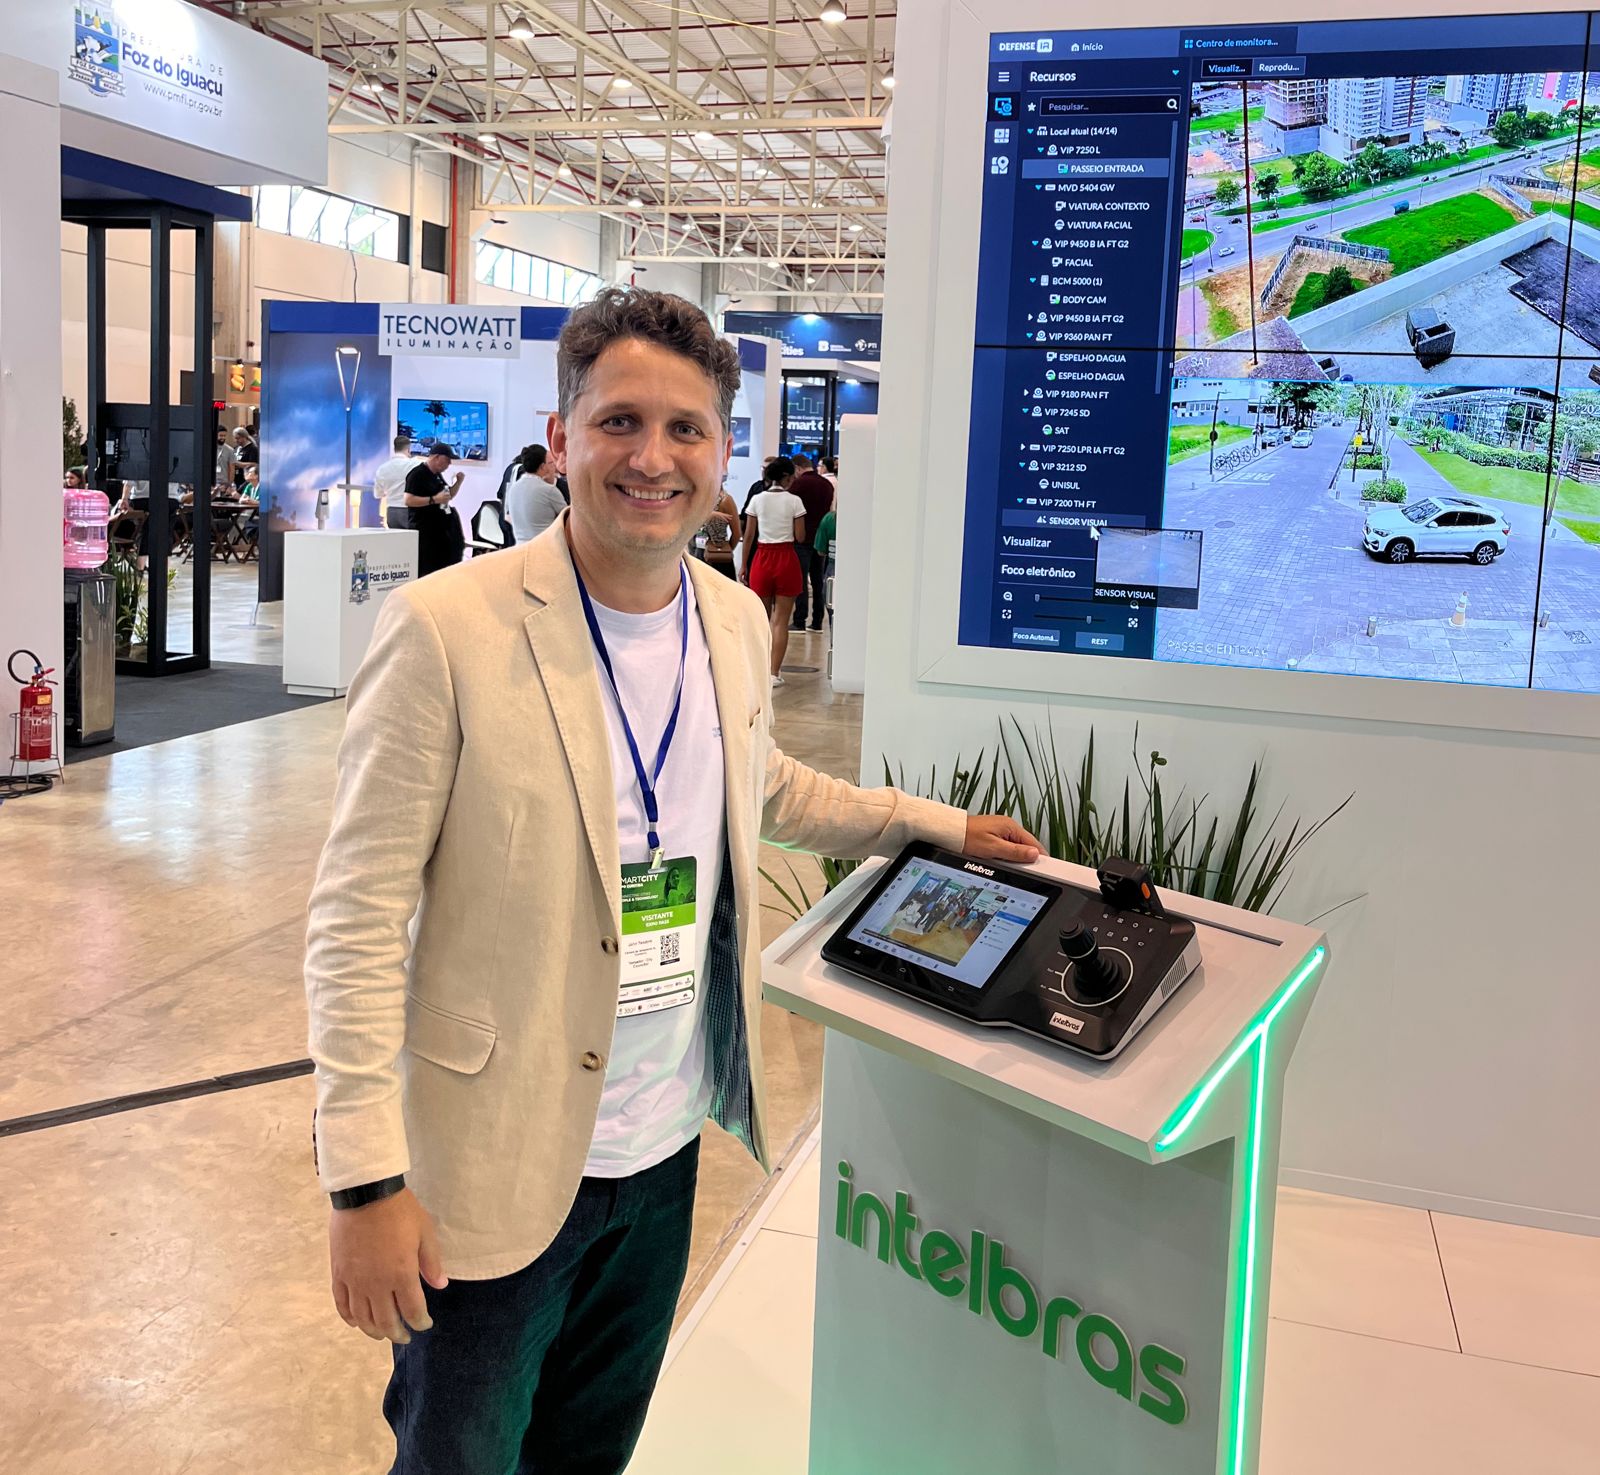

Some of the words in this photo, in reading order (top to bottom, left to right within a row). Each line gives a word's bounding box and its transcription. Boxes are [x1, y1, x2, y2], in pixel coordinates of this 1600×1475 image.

[999, 41, 1036, 52] DEFENSE
[1082, 42, 1104, 52] Início
[1195, 39, 1224, 48] Centro
[1224, 38, 1235, 47] de
[122, 41, 150, 70] Foz
[153, 55, 173, 77] do
[176, 62, 223, 97] Iguaçu
[1258, 63, 1300, 74] Reprodu...
[1029, 71, 1077, 83] Recursos
[143, 82, 223, 118] www.pmfi.pr.gov.br
[1050, 127, 1070, 136] Local
[1070, 127, 1090, 136] atual
[1090, 126, 1118, 137] (14/14)
[1060, 146, 1075, 155] VIP
[1075, 146, 1095, 155] 7250
[1095, 146, 1101, 154] L
[1070, 164, 1104, 173] PASSEIO
[1104, 164, 1145, 173] ENTRADA
[1058, 183, 1079, 192] MVD
[1079, 183, 1099, 192] 5404
[1099, 183, 1116, 192] GW
[1068, 202, 1104, 211] VIATURA
[1104, 202, 1150, 211] CONTEXTO
[1067, 221, 1103, 230] VIATURA
[1103, 221, 1133, 230] FACIAL
[1054, 240, 1069, 248] VIP
[1069, 240, 1090, 249] 9450
[1089, 240, 1096, 249] B
[1096, 240, 1106, 249] IA
[1106, 240, 1117, 249] FT
[1117, 240, 1130, 249] G2
[1064, 258, 1094, 267] FACIAL
[1052, 277, 1072, 286] BCM
[1072, 277, 1092, 286] 5000
[1092, 277, 1103, 287] (1)
[1062, 295, 1087, 304] BODY
[1086, 296, 1107, 304] CAM
[1050, 314, 1064, 323] VIP
[1065, 314, 1085, 323] 9450
[1085, 314, 1091, 323] B
[1092, 314, 1101, 323] IA
[1101, 314, 1112, 323] FT
[1112, 314, 1125, 323] G2
[383, 314, 517, 338] TECNOWATT
[1048, 332, 1063, 341] VIP
[1063, 332, 1083, 341] 9360
[1083, 333, 1102, 341] PAN
[1102, 333, 1113, 342] FT
[386, 337, 513, 353] ILUMINAÇÃO
[781, 344, 804, 356] ities
[1059, 353, 1096, 362] ESPELHO
[1096, 354, 1127, 363] DAGUA
[1190, 357, 1212, 368] SAT
[1058, 371, 1095, 380] ESPELHO
[1094, 372, 1126, 381] DAGUA
[1045, 389, 1060, 398] VIP
[1060, 390, 1080, 398] 9180
[1080, 391, 1098, 399] PAN
[1098, 391, 1109, 399] FT
[1044, 407, 1059, 416] VIP
[1059, 408, 1079, 417] 7245
[1079, 409, 1091, 417] SD
[780, 420, 817, 431] mart
[1054, 426, 1070, 435] SAT
[1042, 444, 1057, 453] VIP
[1057, 445, 1077, 453] 7250
[1077, 445, 1093, 454] LPR
[1093, 446, 1102, 454] IA
[1102, 446, 1113, 455] FT
[1113, 447, 1126, 456] G2
[1041, 462, 1056, 471] VIP
[1056, 463, 1075, 471] 3212
[1075, 463, 1087, 472] SD
[1051, 481, 1081, 490] UNISUL
[1039, 498, 1053, 507] VIP
[1053, 499, 1074, 508] 7200
[1073, 499, 1085, 508] TH
[1085, 500, 1097, 509] FT
[1049, 516, 1081, 526] SENSOR
[1002, 535, 1052, 548] Visualizar
[369, 572, 381, 582] Foz
[381, 571, 390, 581] do
[390, 570, 410, 582] Iguaçu
[1001, 564, 1025, 576] Foco
[1025, 565, 1076, 579] eletrônico
[1094, 588, 1126, 598] SENSOR
[1126, 589, 1157, 600] VISUAL
[1013, 632, 1029, 641] Foco
[1090, 638, 1109, 646] REST
[963, 861, 996, 877] intelbras
[620, 873, 660, 885] MARTCITY
[641, 910, 674, 922] VISITANTE
[1052, 1016, 1081, 1031] intelbras
[834, 1158, 1190, 1426] intelbras
